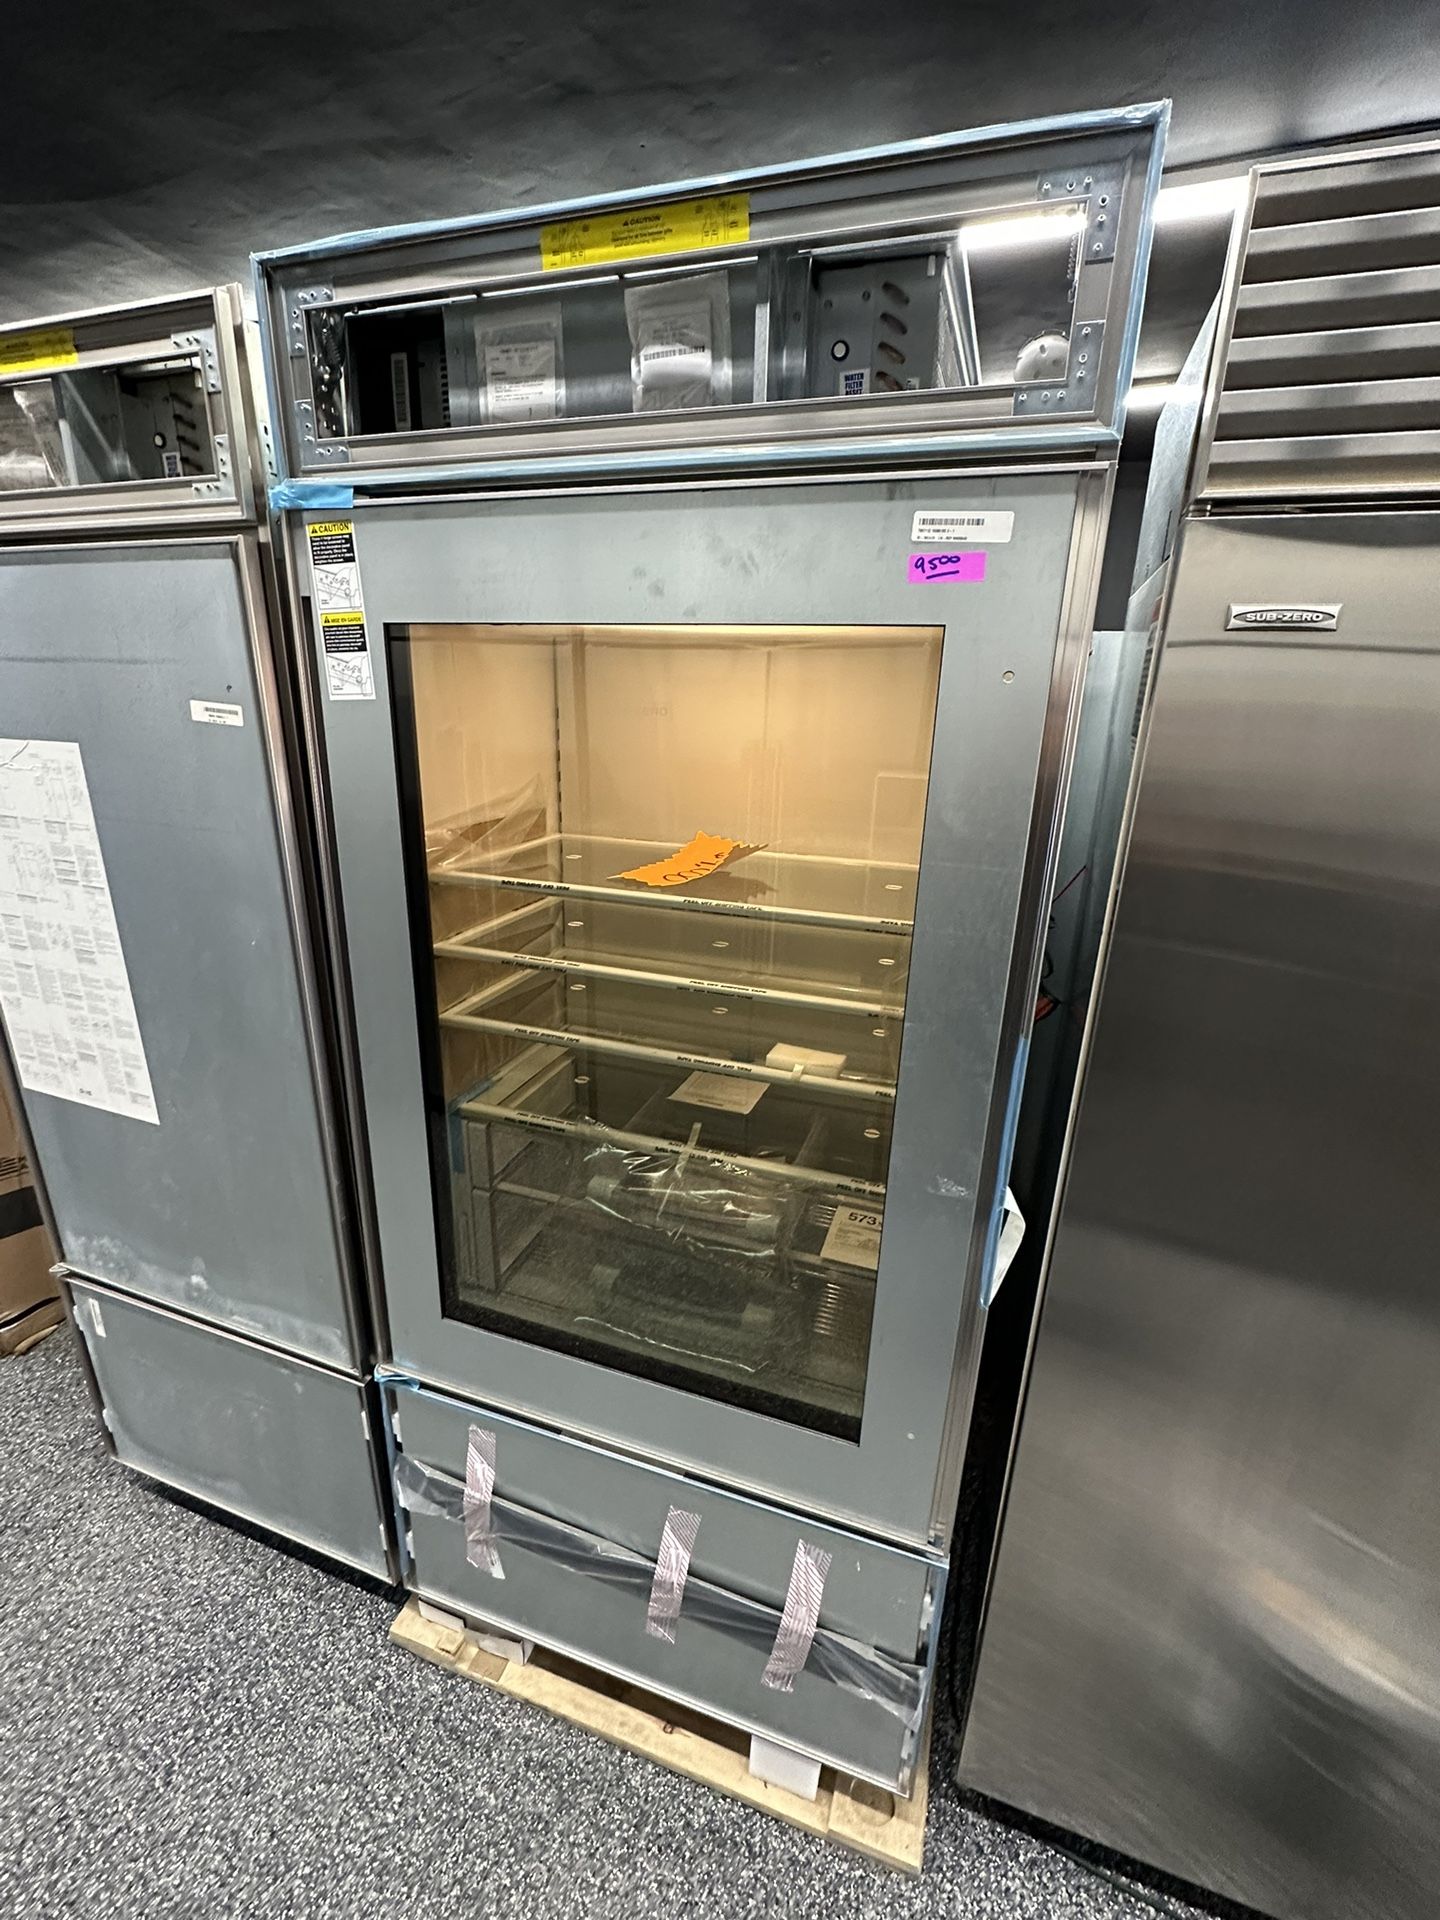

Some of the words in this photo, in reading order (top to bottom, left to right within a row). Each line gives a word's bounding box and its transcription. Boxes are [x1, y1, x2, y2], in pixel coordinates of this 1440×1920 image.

[629, 215, 662, 226] CAUTION
[318, 522, 350, 533] CAUTION
[914, 555, 961, 574] 9500
[1245, 612, 1324, 623] SUB-ZERO
